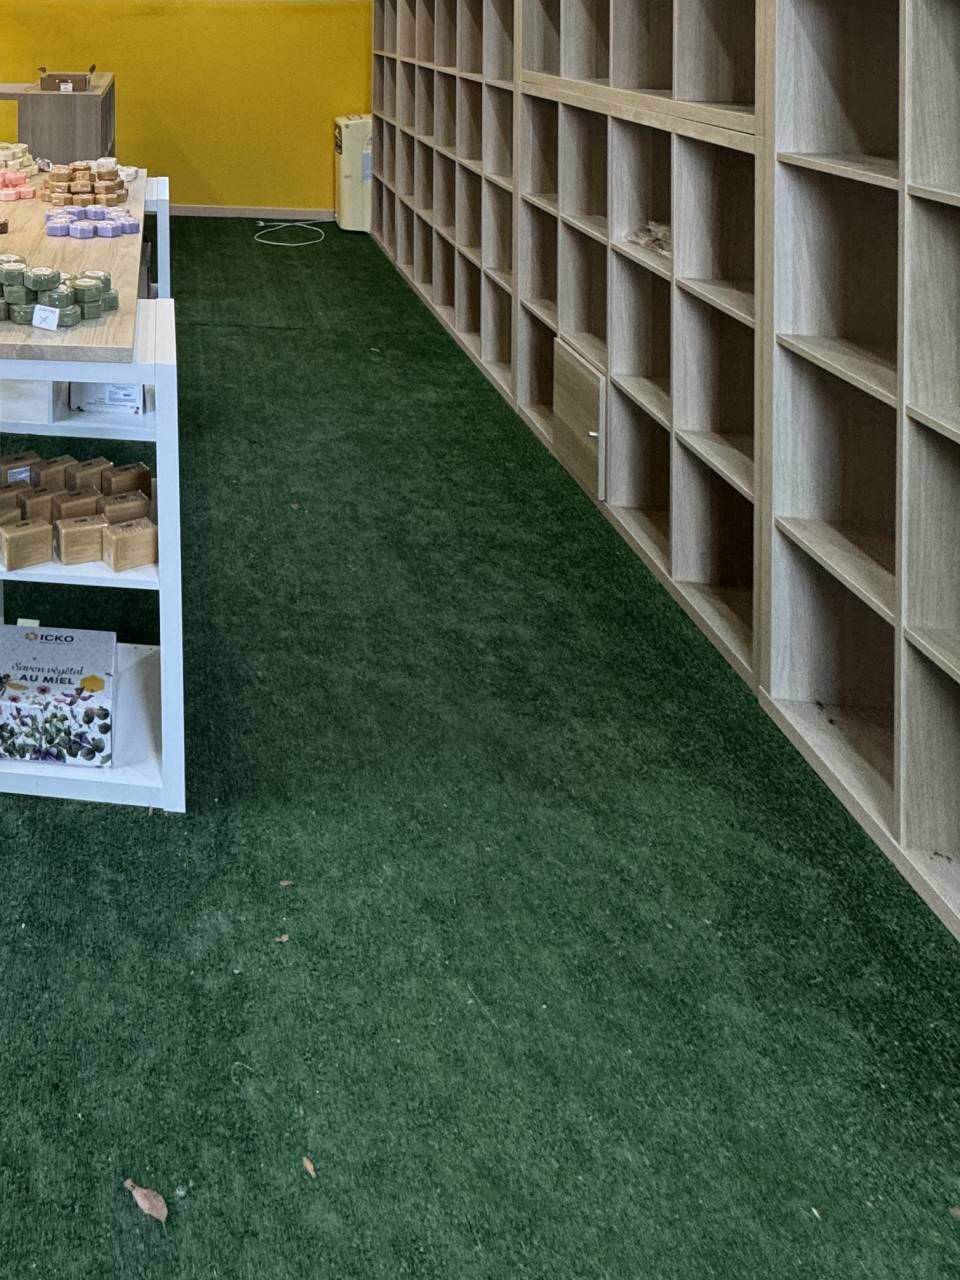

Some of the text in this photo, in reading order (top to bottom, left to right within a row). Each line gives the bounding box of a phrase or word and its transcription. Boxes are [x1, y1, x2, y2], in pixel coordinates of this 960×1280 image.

[40, 634, 75, 643] ICKO
[11, 661, 84, 677] Savon végétal
[19, 674, 75, 685] AU MIEL
